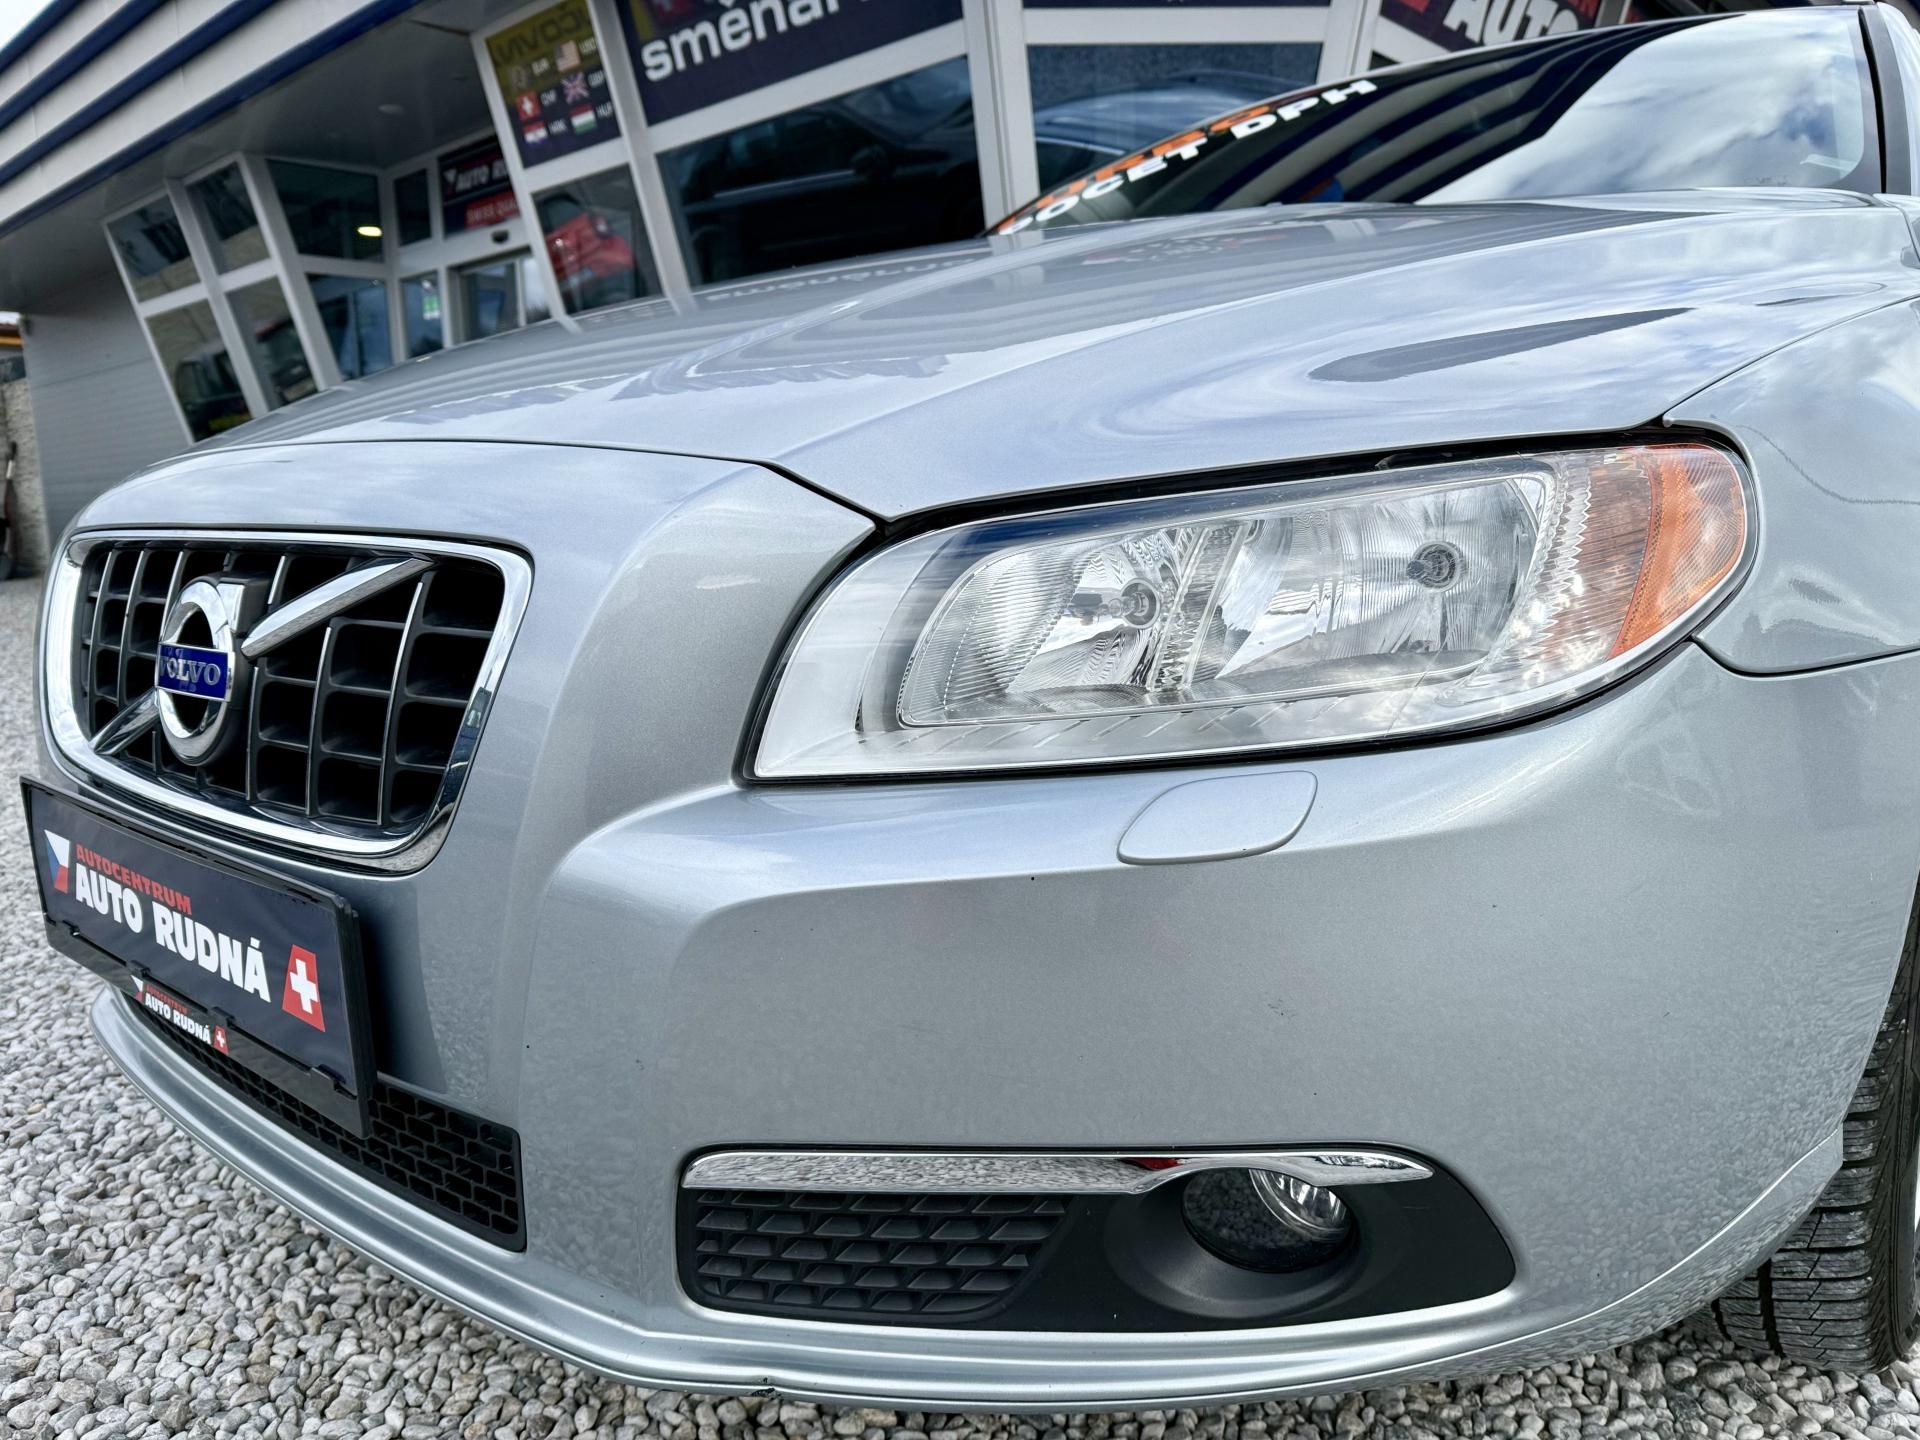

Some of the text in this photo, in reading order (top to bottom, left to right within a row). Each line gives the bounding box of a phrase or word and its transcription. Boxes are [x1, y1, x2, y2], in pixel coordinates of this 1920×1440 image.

[1230, 80, 1378, 139] DPH
[160, 655, 221, 686] VOLVO
[76, 844, 192, 915] AUTOCENTRUM
[76, 863, 271, 1003] AUTO RUDNÁ
[145, 992, 211, 1045] AUTO RUDNÁ
